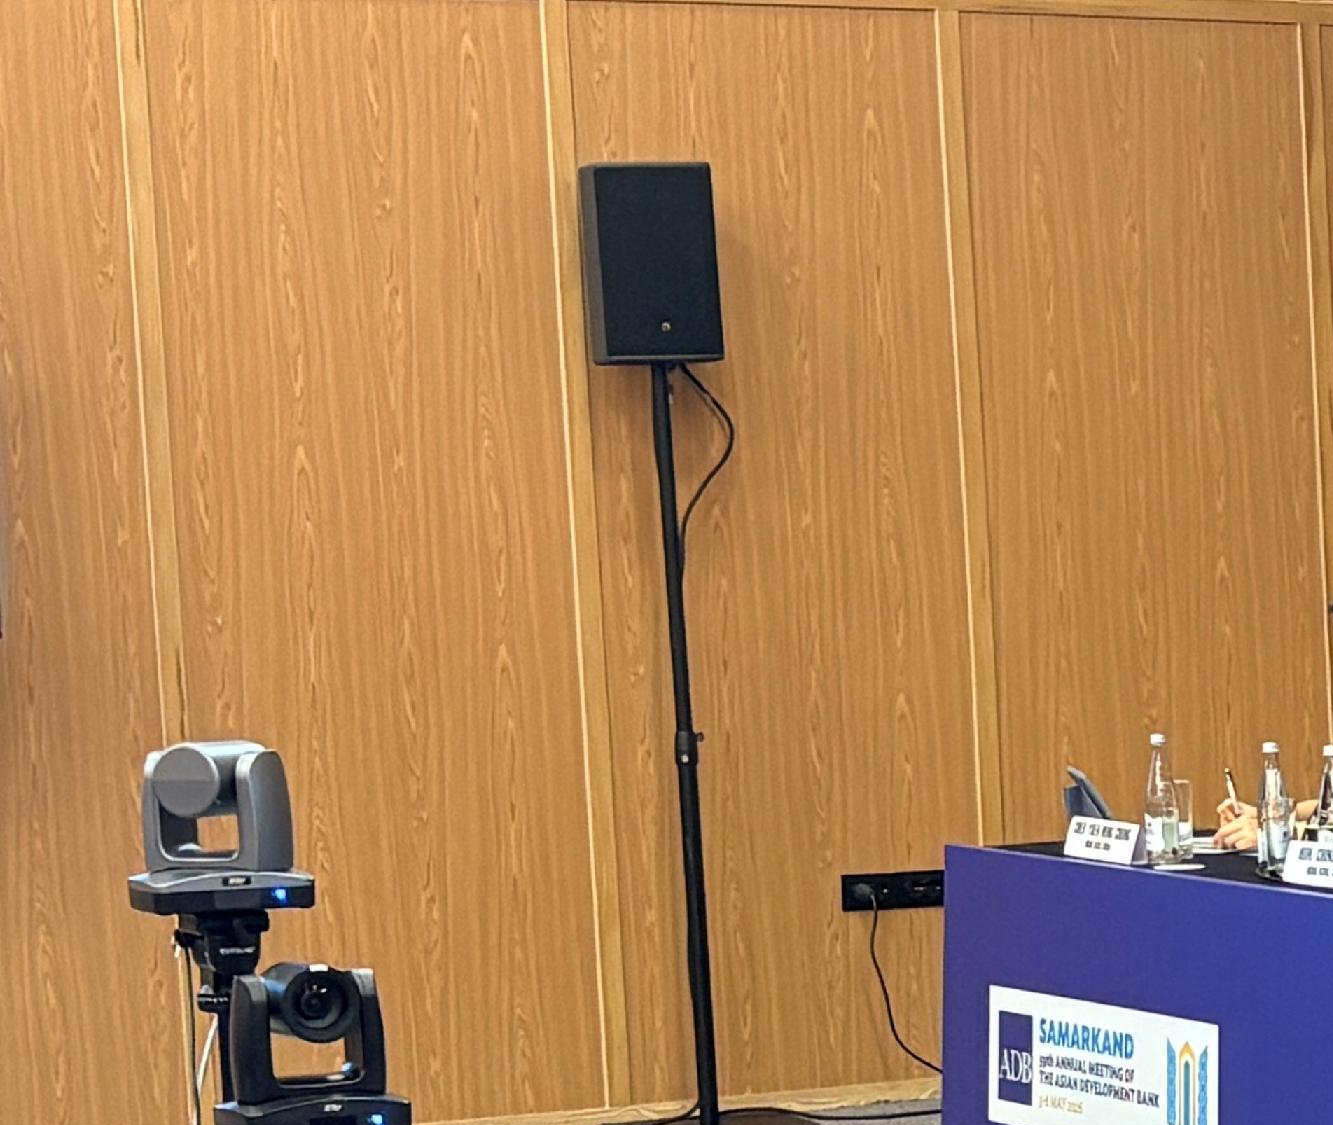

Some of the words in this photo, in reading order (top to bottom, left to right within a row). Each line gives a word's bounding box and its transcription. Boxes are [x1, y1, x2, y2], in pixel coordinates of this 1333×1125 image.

[1039, 1018, 1134, 1060] SAMARKAND
[999, 1047, 1033, 1085] ADB
[1055, 1057, 1087, 1074] ANNUAL
[1089, 1061, 1123, 1081] MEETING
[1125, 1067, 1134, 1084] OF
[1039, 1071, 1054, 1086] THE
[1055, 1073, 1078, 1091] ASIAN
[1080, 1077, 1135, 1105] DEVELOPMENT
[1137, 1089, 1160, 1109] BANK
